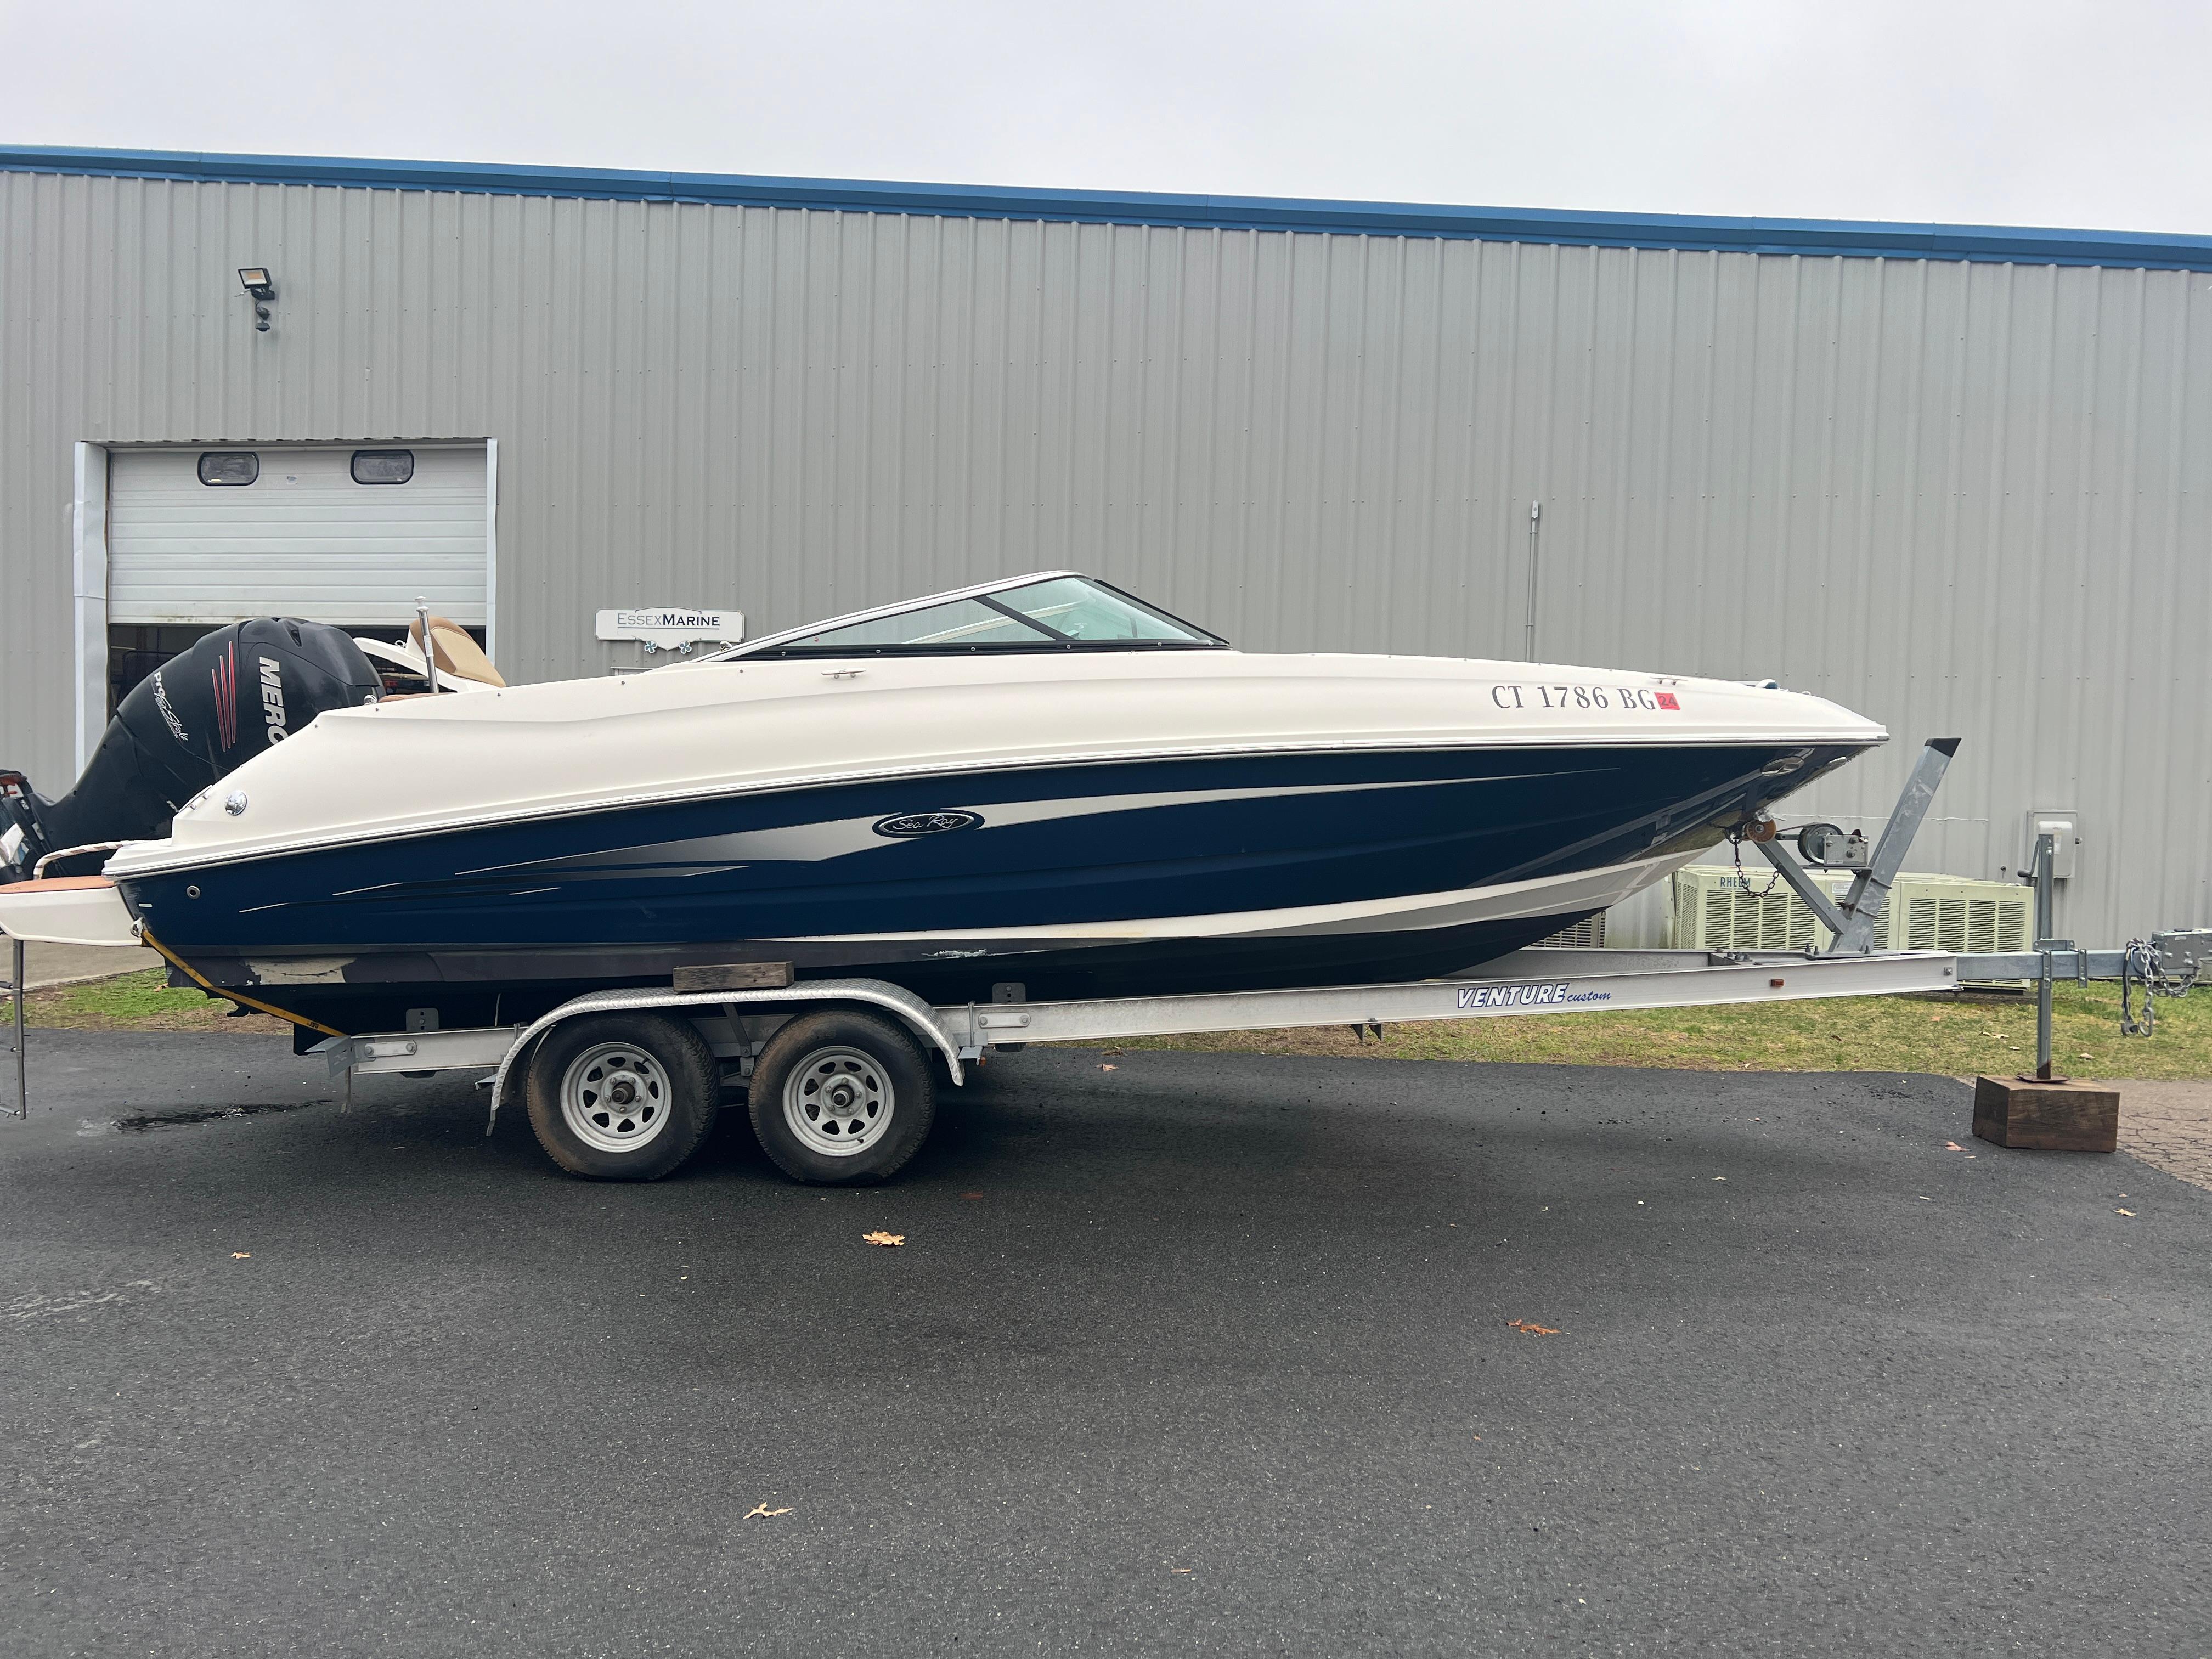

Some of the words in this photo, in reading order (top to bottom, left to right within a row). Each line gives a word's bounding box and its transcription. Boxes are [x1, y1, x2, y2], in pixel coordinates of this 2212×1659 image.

[1492, 685, 1522, 709] CT
[1537, 686, 1609, 709] 1786
[1616, 687, 1656, 710] BG
[1658, 695, 1678, 706] 24
[892, 819, 924, 830] Sea
[927, 815, 959, 828] Ray
[1720, 877, 1751, 888] RHEEM
[1457, 983, 1570, 1008] VENTURE
[1567, 990, 1612, 1002] custom
